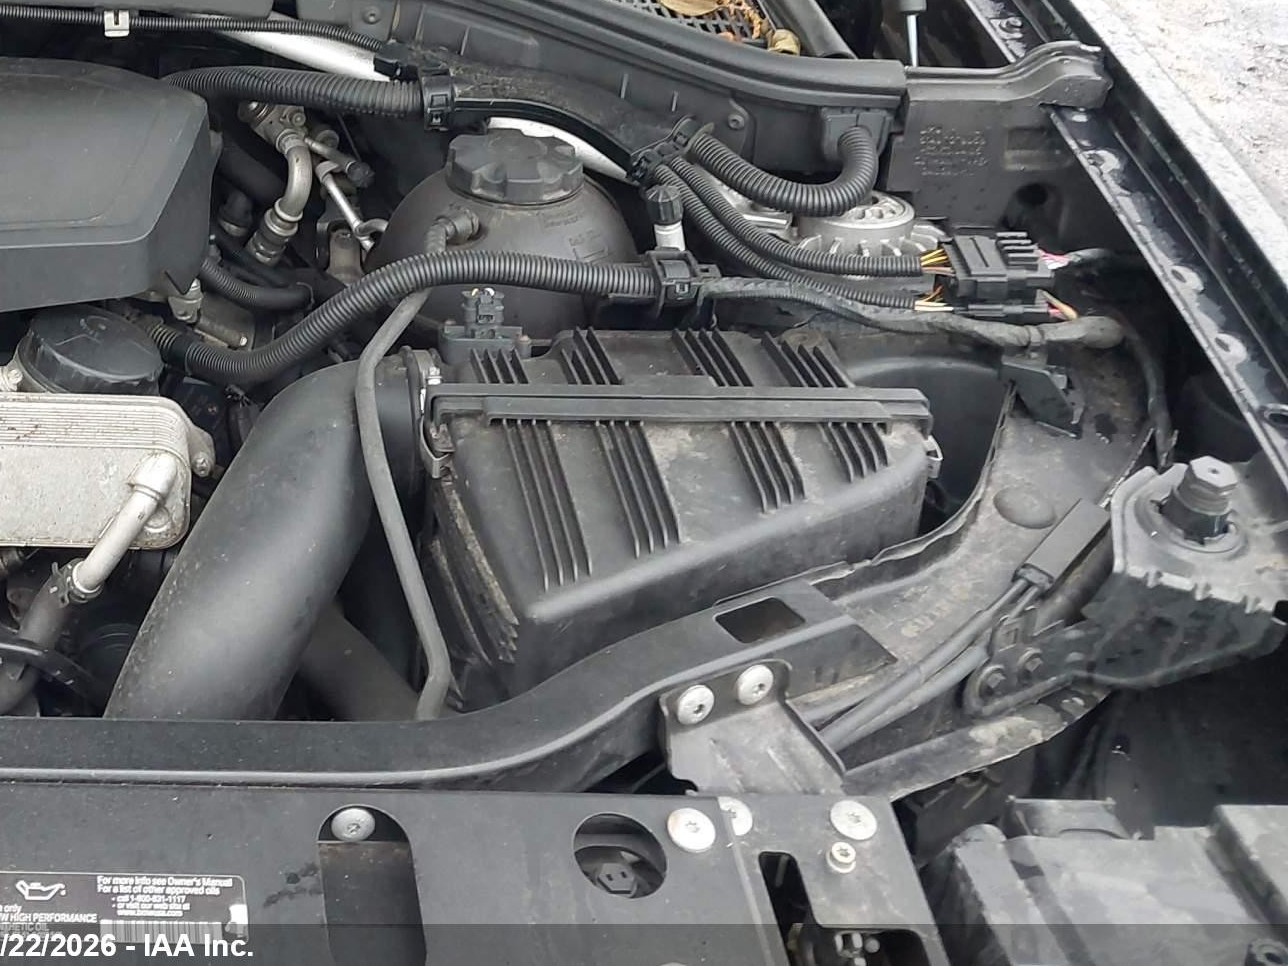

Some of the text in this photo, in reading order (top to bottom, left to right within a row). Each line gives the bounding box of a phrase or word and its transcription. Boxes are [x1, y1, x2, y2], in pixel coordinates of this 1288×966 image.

[97, 875, 111, 884] For
[112, 877, 134, 885] more
[152, 877, 167, 885] see
[97, 884, 111, 893] For
[132, 885, 142, 893] of
[143, 886, 165, 894] other
[166, 886, 204, 895] approved
[4, 903, 22, 915] only
[10, 913, 32, 922] HIGH
[33, 913, 98, 923] PERFORMANCE
